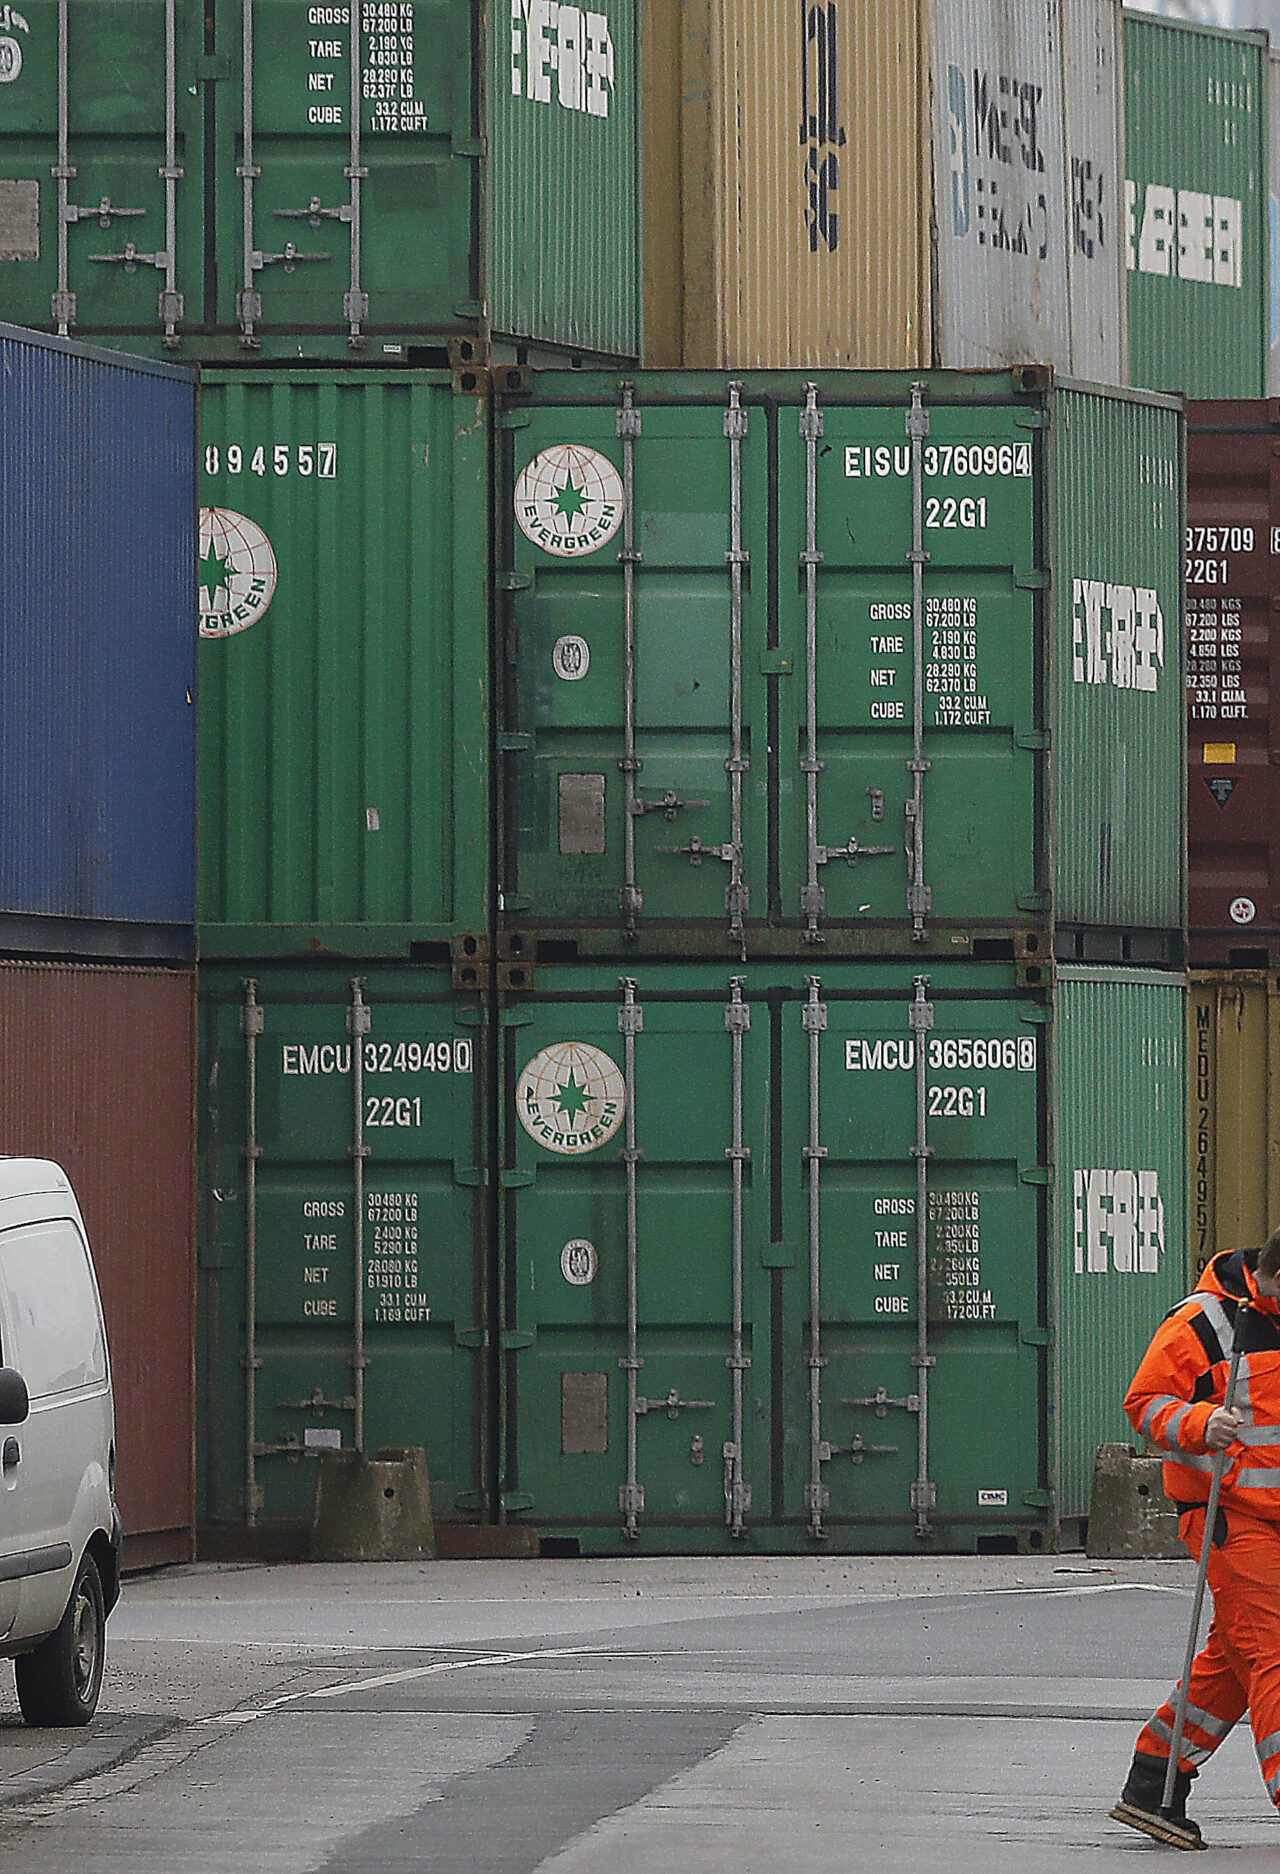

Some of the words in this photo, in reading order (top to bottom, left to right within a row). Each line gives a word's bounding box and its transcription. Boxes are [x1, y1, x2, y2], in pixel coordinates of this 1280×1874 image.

[308, 7, 350, 24] GROSS
[400, 3, 413, 17] KG
[308, 40, 342, 57] TARE
[308, 73, 334, 91] NET
[400, 69, 413, 83] KG
[400, 84, 413, 98] LB
[308, 106, 342, 123] CUBE
[845, 446, 911, 477] EISU
[925, 442, 1032, 478] 3760964
[926, 497, 987, 528] 22G1
[523, 504, 616, 549] EVERGREEN
[1186, 527, 1254, 552] 375709
[1185, 559, 1228, 584] 22G1
[199, 578, 266, 630] GREEN
[870, 603, 912, 620] GROSS
[926, 598, 960, 612] 30.480
[963, 598, 977, 612] KG
[926, 613, 960, 627] 67.200
[963, 613, 976, 627] LB
[932, 631, 960, 645] 2.190
[963, 631, 977, 645] KG
[1221, 629, 1242, 642] KGS
[870, 636, 904, 653] TARE
[963, 646, 976, 660] LB
[870, 669, 896, 686] NET
[963, 664, 977, 678] KG
[926, 679, 960, 693] 62.370
[963, 679, 976, 692] LB
[870, 702, 904, 719] CUBE
[939, 696, 961, 710] 33.2
[935, 711, 961, 725] 1.172
[283, 1045, 351, 1075] EMCU
[364, 1038, 473, 1073] 3249490
[845, 1040, 914, 1070] EMCU
[928, 1036, 1036, 1071] 3656068
[928, 1086, 987, 1117] 22G1
[365, 1096, 422, 1127] 22G1
[526, 1101, 617, 1147] EVERGREEN
[405, 1193, 418, 1207] KG
[874, 1198, 915, 1215] GROSS
[303, 1201, 345, 1217] GROSS
[405, 1208, 418, 1221] LB
[405, 1226, 418, 1240] KG
[875, 1231, 907, 1248] TARE
[303, 1234, 337, 1250] TARE
[405, 1241, 418, 1254] LB
[405, 1260, 418, 1273] KG
[874, 1264, 900, 1280] NET
[304, 1267, 329, 1283] NET
[405, 1275, 418, 1288] LB
[304, 1300, 337, 1316] CUBE
[875, 1297, 909, 1313] CUBE
